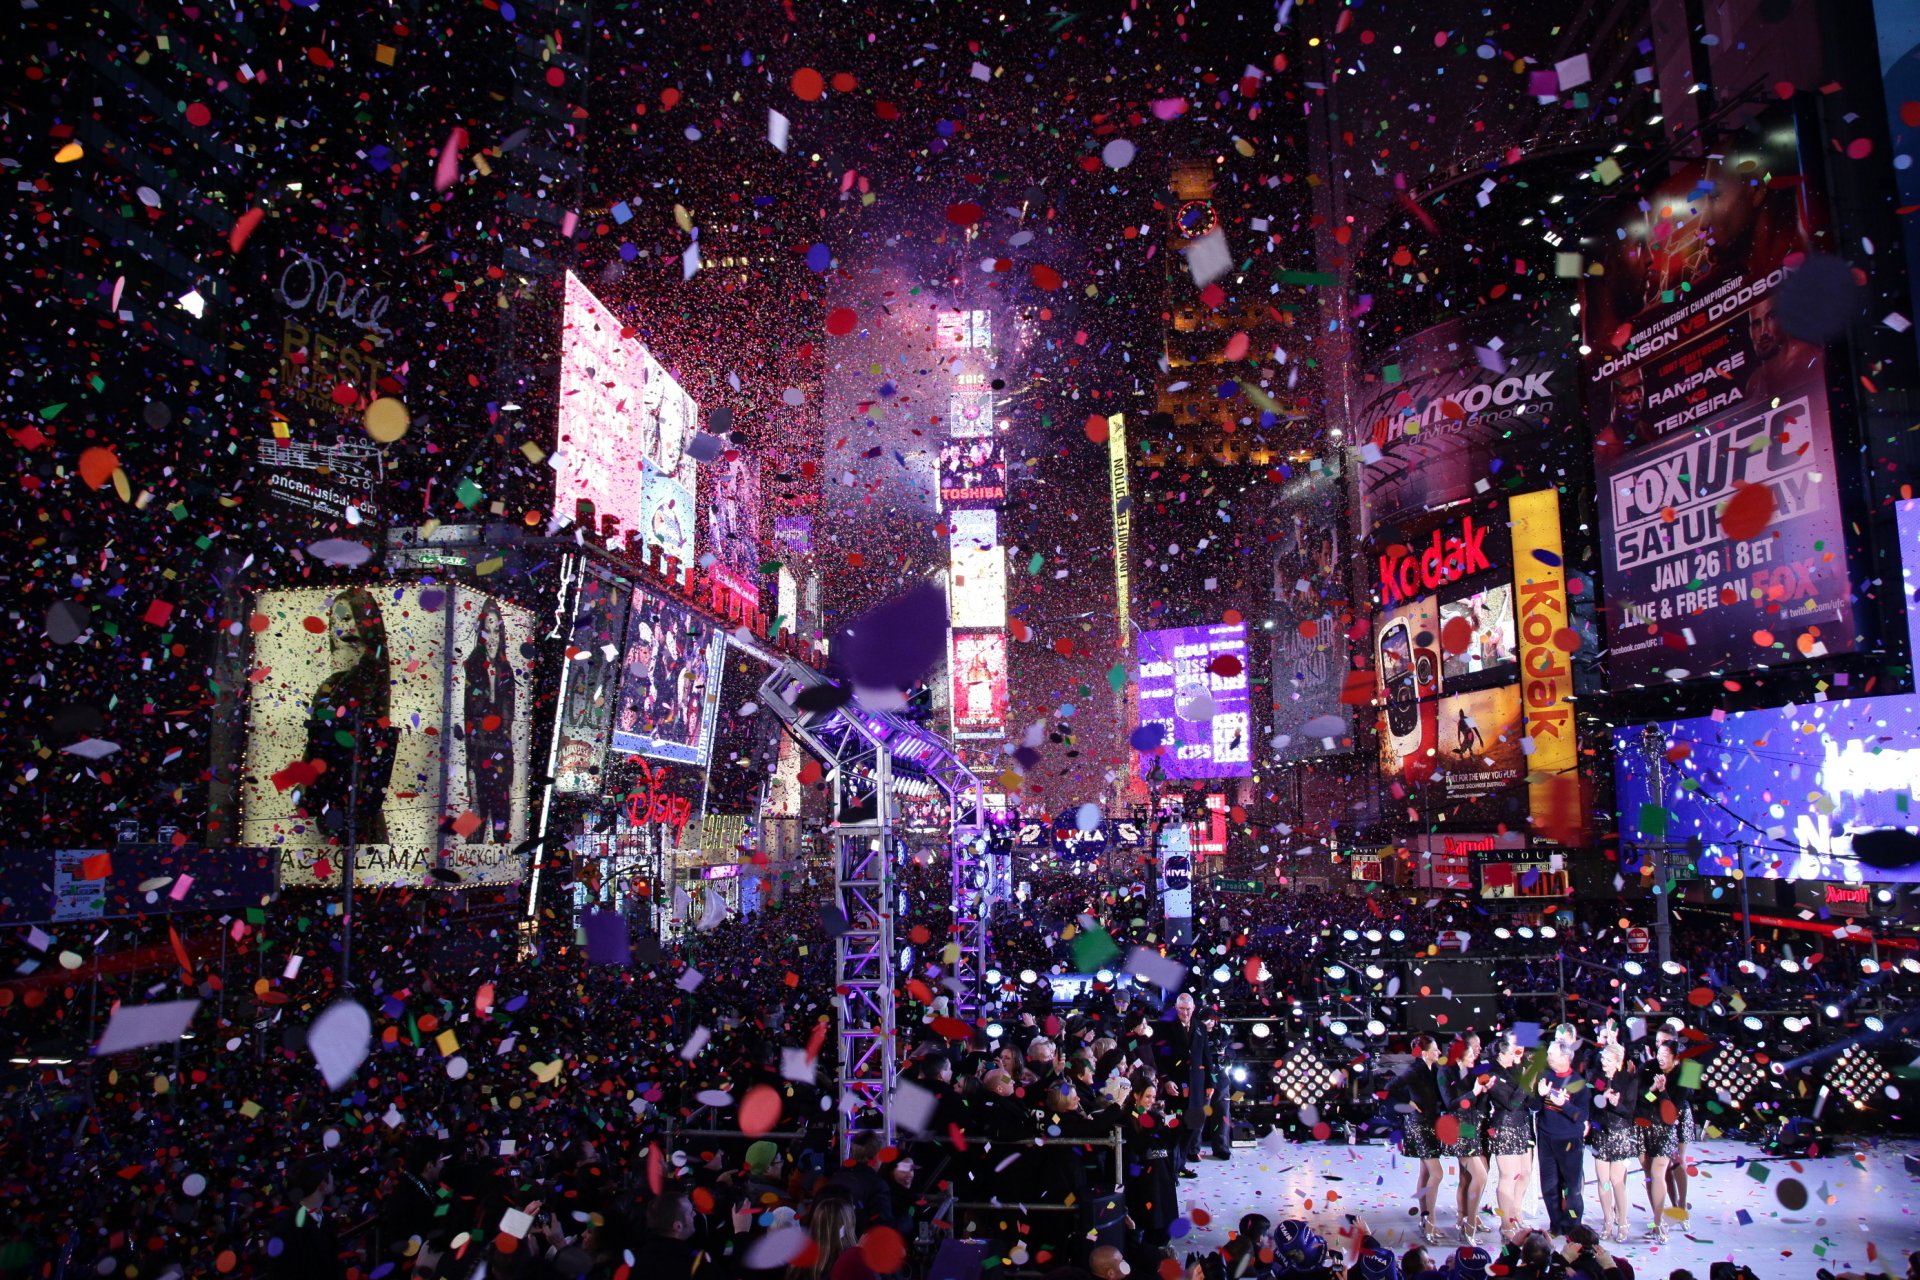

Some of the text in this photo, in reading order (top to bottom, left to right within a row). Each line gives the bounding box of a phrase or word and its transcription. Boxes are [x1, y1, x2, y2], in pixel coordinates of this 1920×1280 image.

[1629, 275, 1744, 346] WORLD FLYWEIGHT CHAMPIONSHIP
[282, 320, 385, 390] BEST
[1592, 327, 1679, 382] JOHNSON
[1680, 311, 1710, 335] VS
[957, 374, 985, 385] 2013
[1647, 350, 1746, 408] RAMPAGE
[1684, 387, 1710, 405] VS
[1653, 386, 1744, 435] TEIXEIRA
[1409, 420, 1463, 446] driving
[1614, 402, 1807, 526] FOX UFC
[942, 486, 1005, 500] TOSHIBA
[1379, 516, 1491, 605] Kodak
[1651, 558, 1688, 594] JAN
[1694, 550, 1720, 581] 26
[1752, 557, 1820, 609] FOX
[1623, 603, 1657, 628] LIVE
[1660, 597, 1673, 620] &
[1676, 584, 1719, 616] FREE
[1520, 579, 1569, 740] Kodak
[1479, 771, 1491, 780] WAY
[1491, 770, 1503, 779] YOU
[1056, 829, 1105, 842] VEA
[1442, 836, 1495, 860] Marriott
[1825, 885, 1868, 903] Marriott
